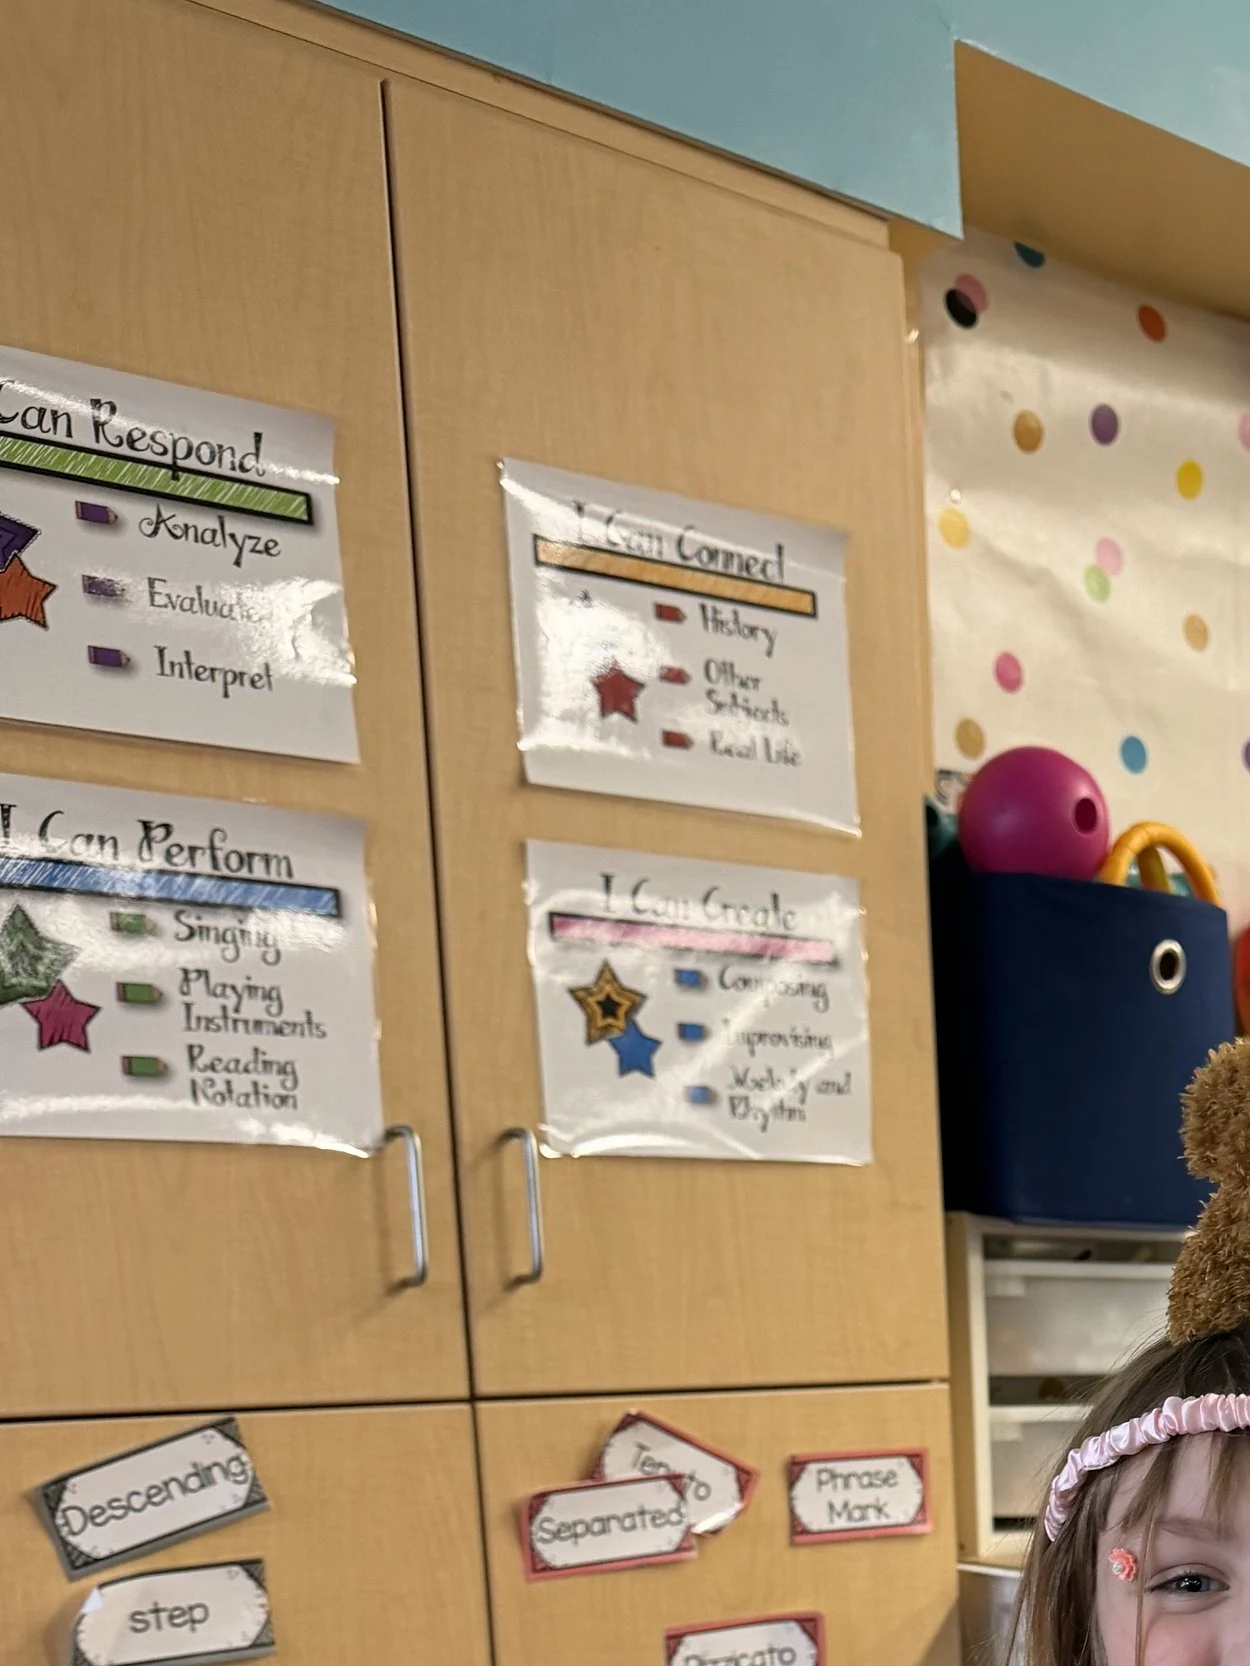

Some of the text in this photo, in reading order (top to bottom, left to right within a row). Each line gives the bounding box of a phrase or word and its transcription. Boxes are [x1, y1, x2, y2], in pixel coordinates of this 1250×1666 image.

[90, 398, 266, 481] Respond
[139, 504, 282, 568] Analyze
[604, 509, 664, 558] Can
[676, 525, 785, 581] Connect
[698, 602, 779, 658] History
[153, 645, 273, 698] Interpret
[704, 658, 762, 690] Other
[705, 687, 790, 727] Subjects
[710, 729, 802, 768] Real Life
[0, 803, 294, 878] I Can Perform
[600, 873, 797, 932] I Can Create
[175, 909, 282, 966] Singing
[179, 968, 283, 1017] Playing
[183, 1005, 327, 1040] Instruments
[186, 1045, 299, 1091] Reading
[815, 1072, 852, 1096] and
[190, 1080, 298, 1109] Notation
[62, 1452, 249, 1537] Descending
[631, 1440, 712, 1502] Tento
[815, 1467, 899, 1492] Phrase
[536, 1502, 686, 1548] Separated
[828, 1500, 890, 1524] Mark
[128, 1600, 210, 1635] step
